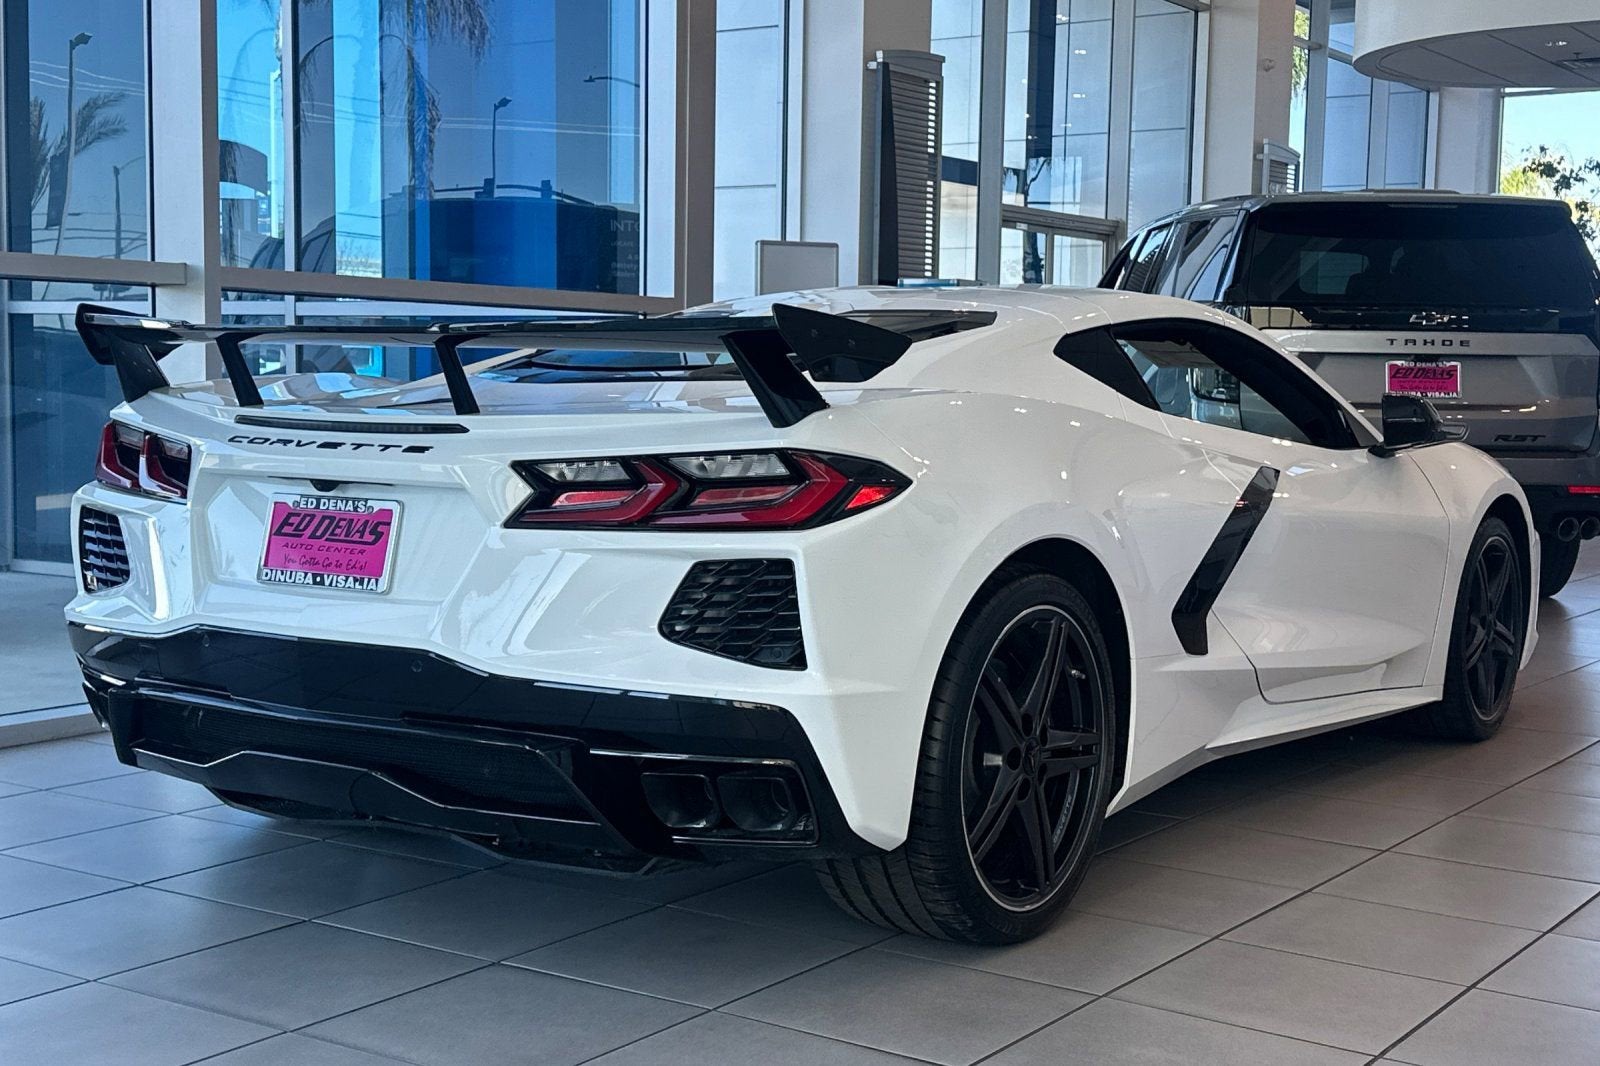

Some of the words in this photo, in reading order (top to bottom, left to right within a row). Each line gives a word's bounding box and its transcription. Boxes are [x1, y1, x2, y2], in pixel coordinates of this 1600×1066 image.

[1386, 338, 1471, 347] TAHOE
[1391, 367, 1415, 379] ED
[227, 435, 434, 454] CORVETTE
[1494, 434, 1546, 442] RST
[300, 497, 316, 508] ED
[319, 498, 366, 513] DENA'S
[273, 511, 316, 538] ED
[308, 515, 391, 546] DENA'S
[282, 542, 314, 551] AUTO
[317, 545, 367, 555] CENTER
[283, 553, 297, 564] You
[300, 554, 321, 566] Gotta
[322, 557, 333, 569] Go
[334, 560, 343, 569] to
[345, 558, 368, 572] Ed's!
[262, 568, 313, 585] DINUBA
[324, 574, 377, 591] VISALIA
